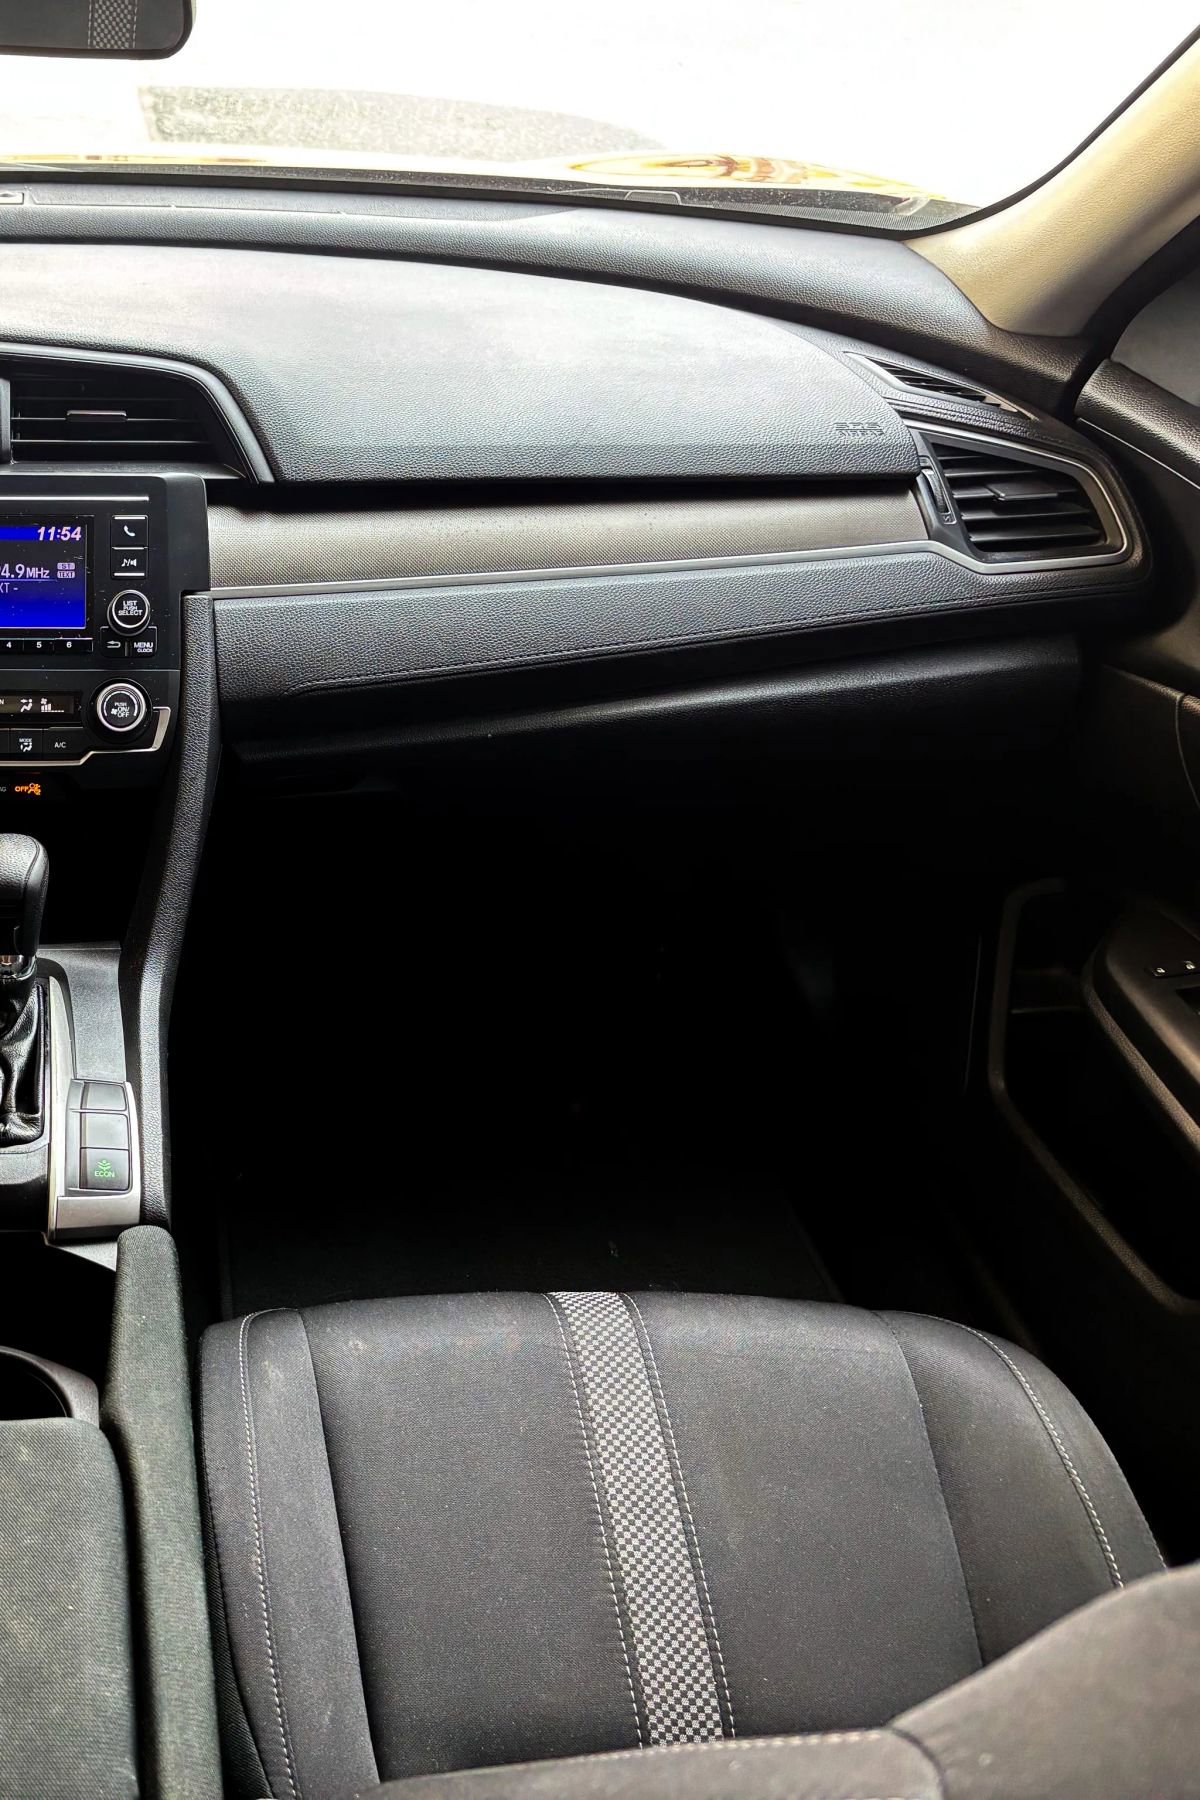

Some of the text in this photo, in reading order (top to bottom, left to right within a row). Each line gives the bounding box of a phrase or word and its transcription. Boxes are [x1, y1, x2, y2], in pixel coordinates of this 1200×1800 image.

[37, 526, 82, 541] 11:54
[26, 566, 50, 578] MHz
[94, 1170, 116, 1178] ECON
